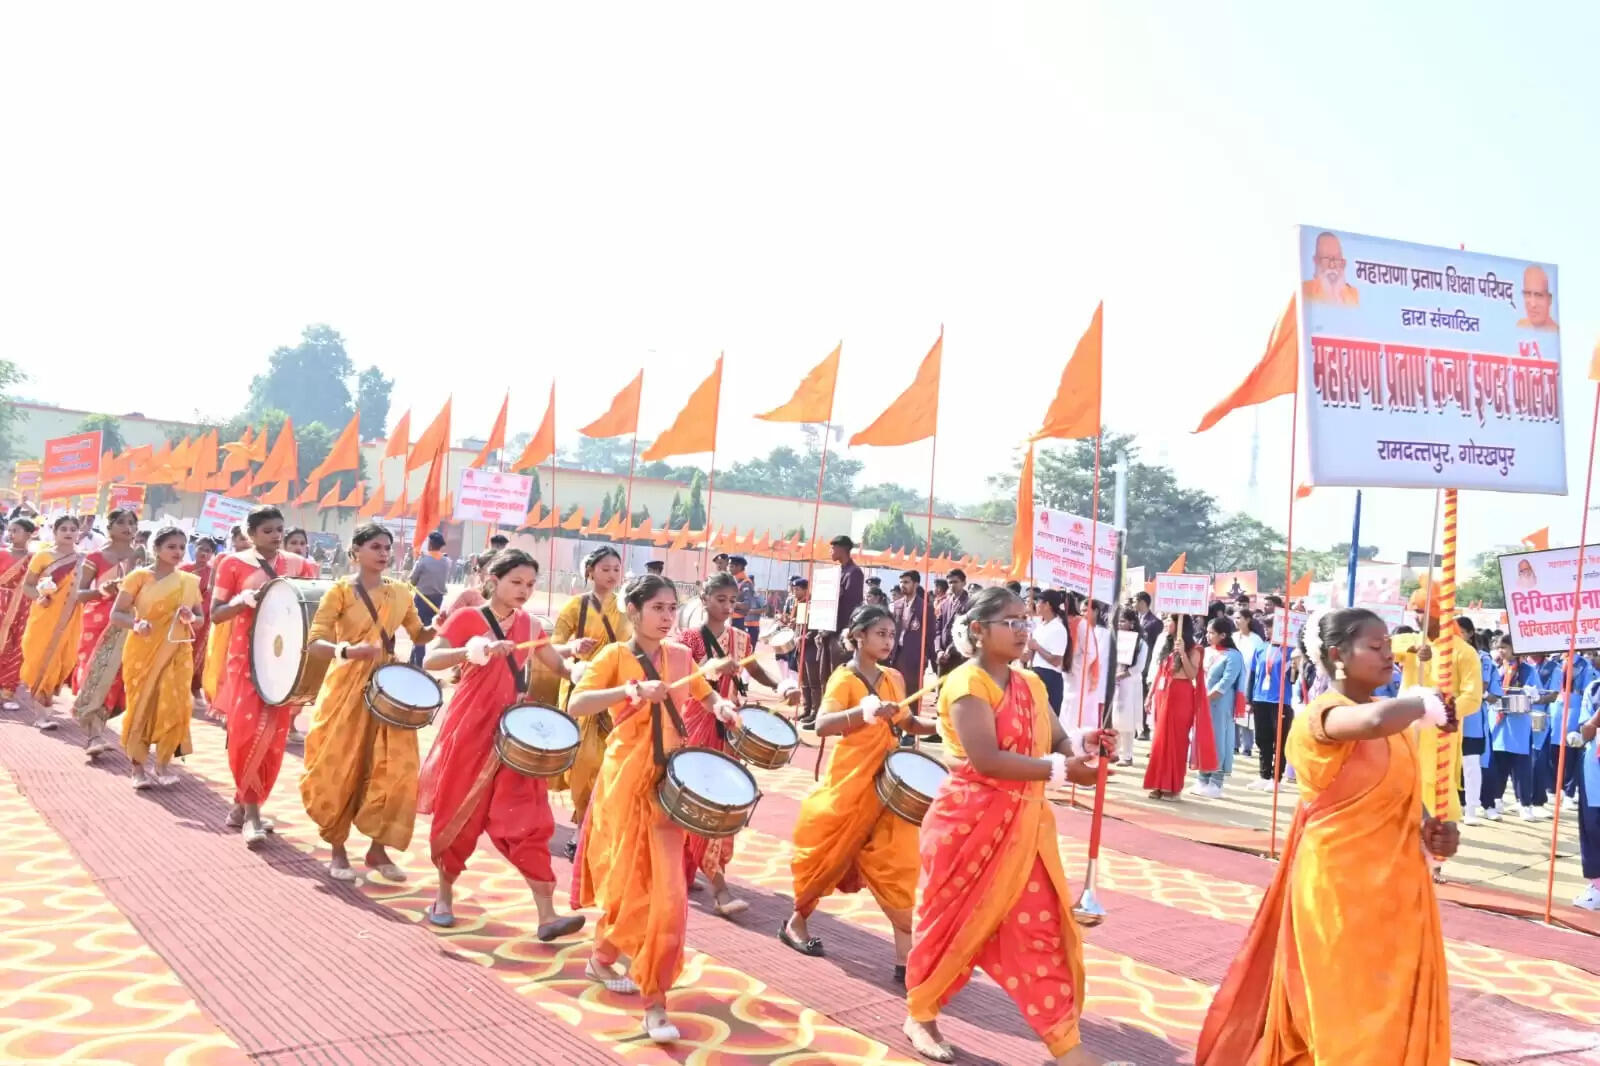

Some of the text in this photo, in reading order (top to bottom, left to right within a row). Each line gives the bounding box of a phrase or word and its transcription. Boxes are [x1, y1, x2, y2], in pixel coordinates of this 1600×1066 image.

[1355, 260, 1408, 286] महाराणा
[1410, 266, 1442, 292] प्रताप
[1445, 265, 1476, 295] शिक्षा
[1401, 308, 1480, 332] द्वारा संचालित
[1312, 336, 1383, 410] महाराणा
[1384, 343, 1427, 414] प्रताप
[1428, 347, 1472, 418] कन्या
[1377, 438, 1515, 476] रामदत्तपुर, गोरखपुर
[1511, 589, 1600, 616] दिग्विजयना
[1518, 618, 1600, 637] दिग्विजयना इण्ट
